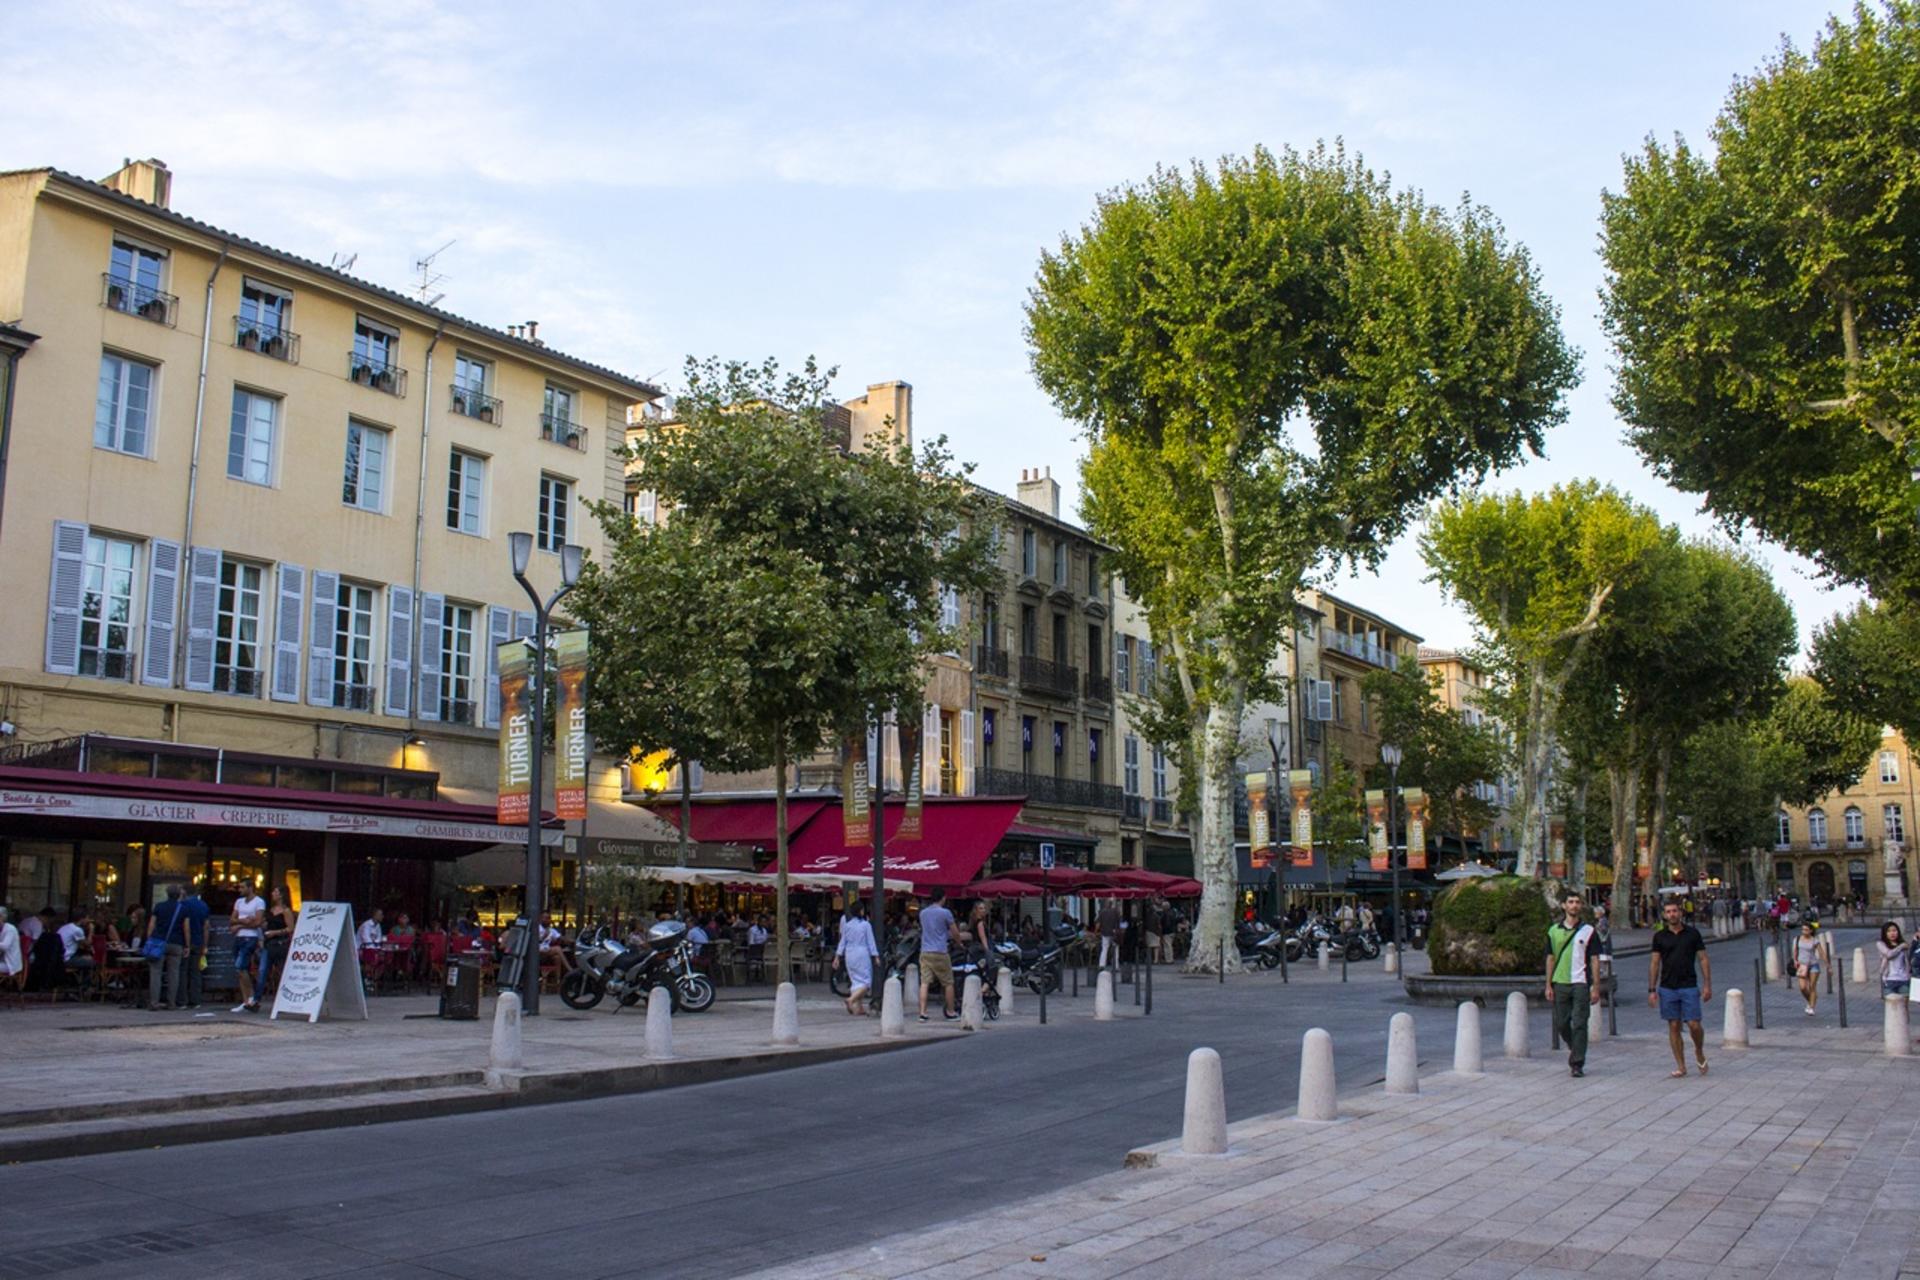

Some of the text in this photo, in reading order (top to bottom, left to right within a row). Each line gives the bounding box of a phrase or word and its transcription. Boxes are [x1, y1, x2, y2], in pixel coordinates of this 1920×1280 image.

[509, 713, 529, 786] TURNER
[569, 707, 585, 780] TURNER
[853, 761, 869, 816] TURNER
[128, 803, 289, 826] GLACIER CREPERIE
[415, 824, 473, 838] CHAMBRES
[598, 839, 644, 857] Giovanni
[292, 932, 336, 950] FORMULE
